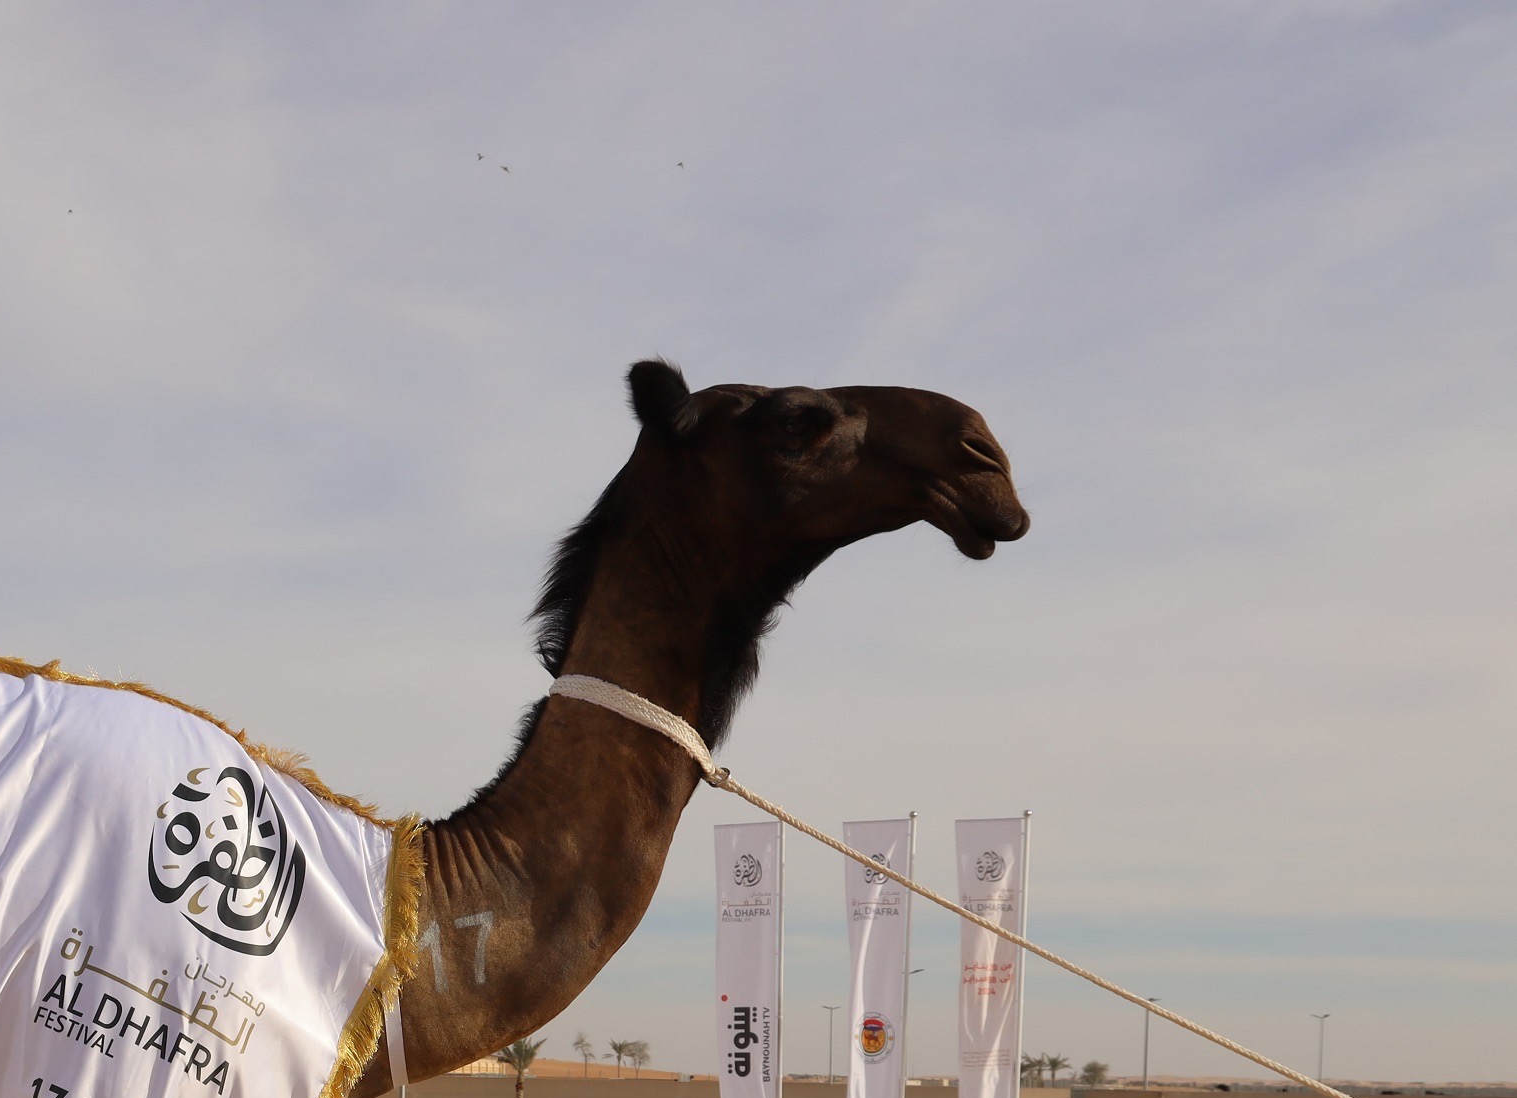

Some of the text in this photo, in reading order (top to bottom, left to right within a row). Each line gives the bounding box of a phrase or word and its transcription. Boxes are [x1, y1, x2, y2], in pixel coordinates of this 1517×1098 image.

[722, 908, 771, 918] AL DHAFRA
[184, 956, 266, 1017] مهرجان
[418, 911, 494, 993] 17
[60, 927, 256, 1055] الظفرة
[33, 1006, 115, 1059] FESTIVAL
[42, 973, 230, 1096] AL DHAFRA
[762, 1006, 771, 1082] BAYNOUNAH TV
